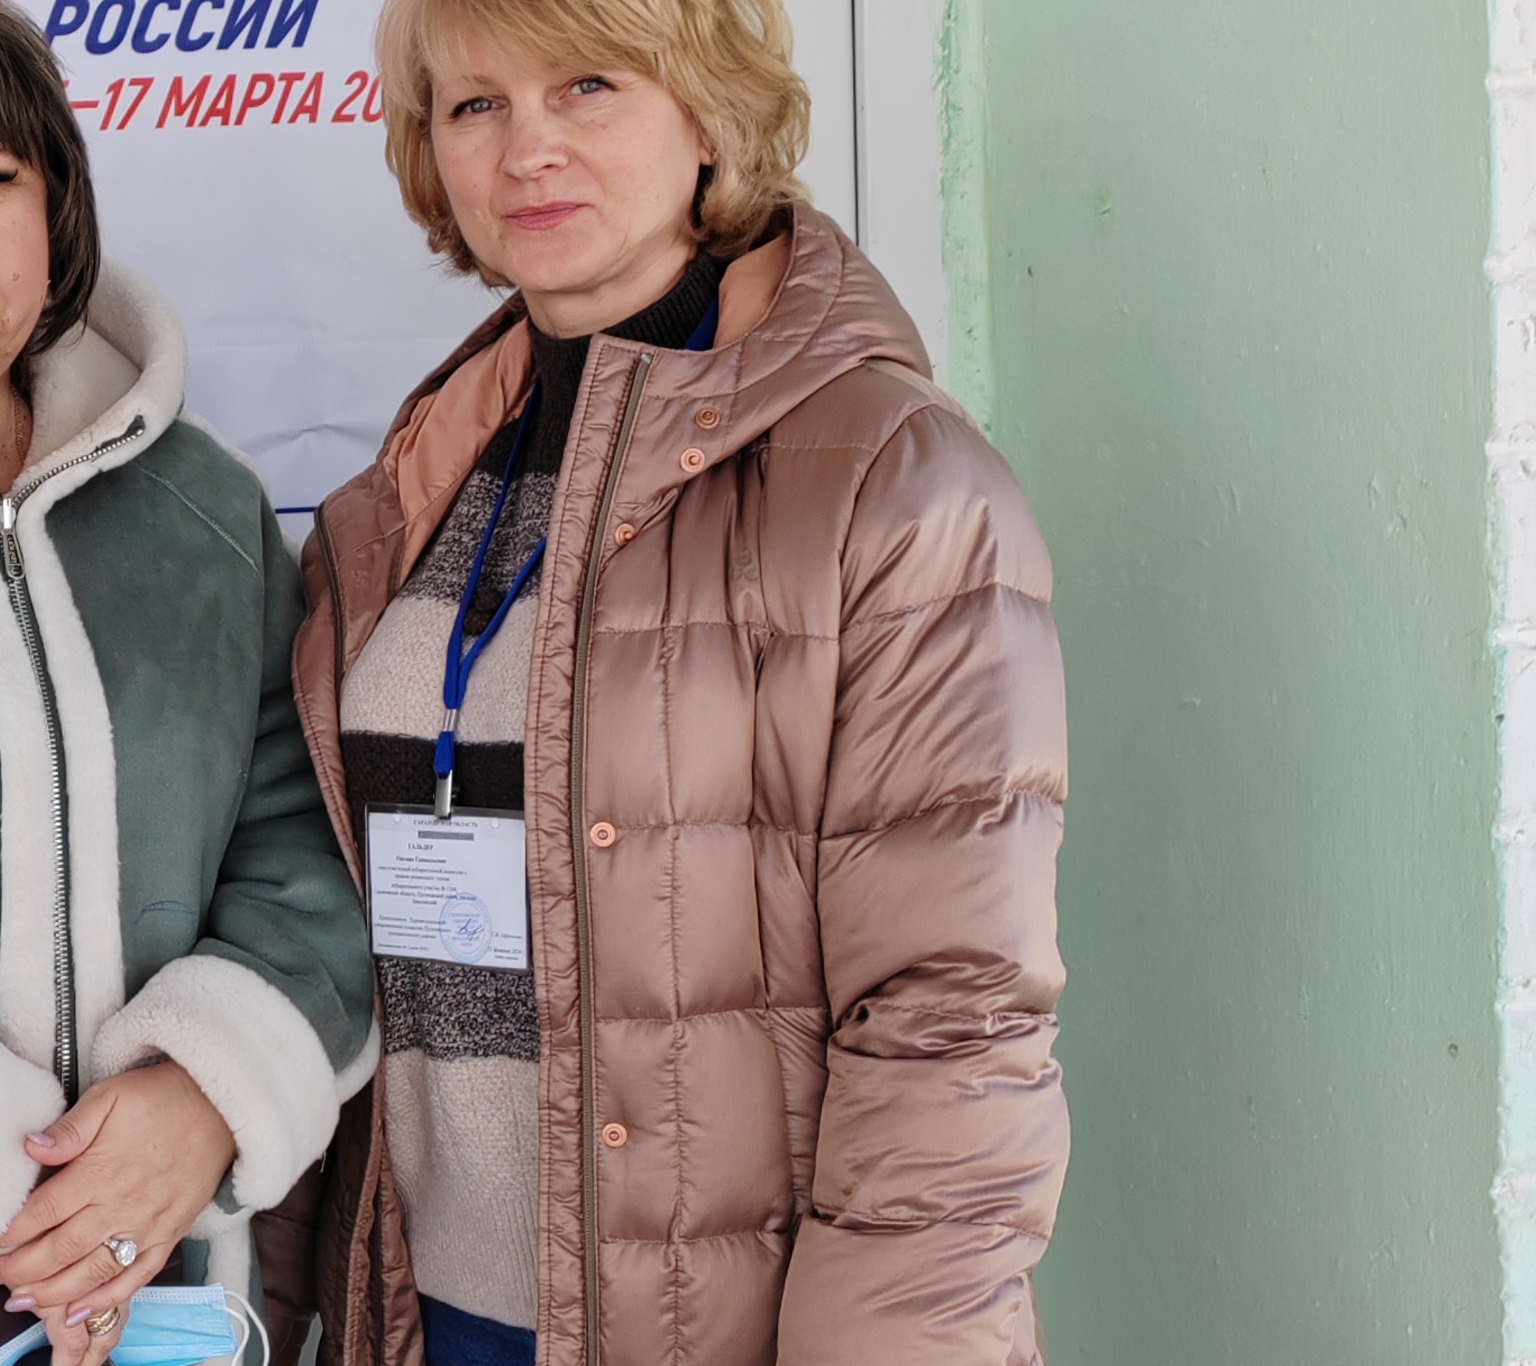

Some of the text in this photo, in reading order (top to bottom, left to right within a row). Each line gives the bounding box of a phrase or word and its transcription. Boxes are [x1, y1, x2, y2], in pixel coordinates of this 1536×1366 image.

[64, 70, 383, 131] –17 МАРТА 20
